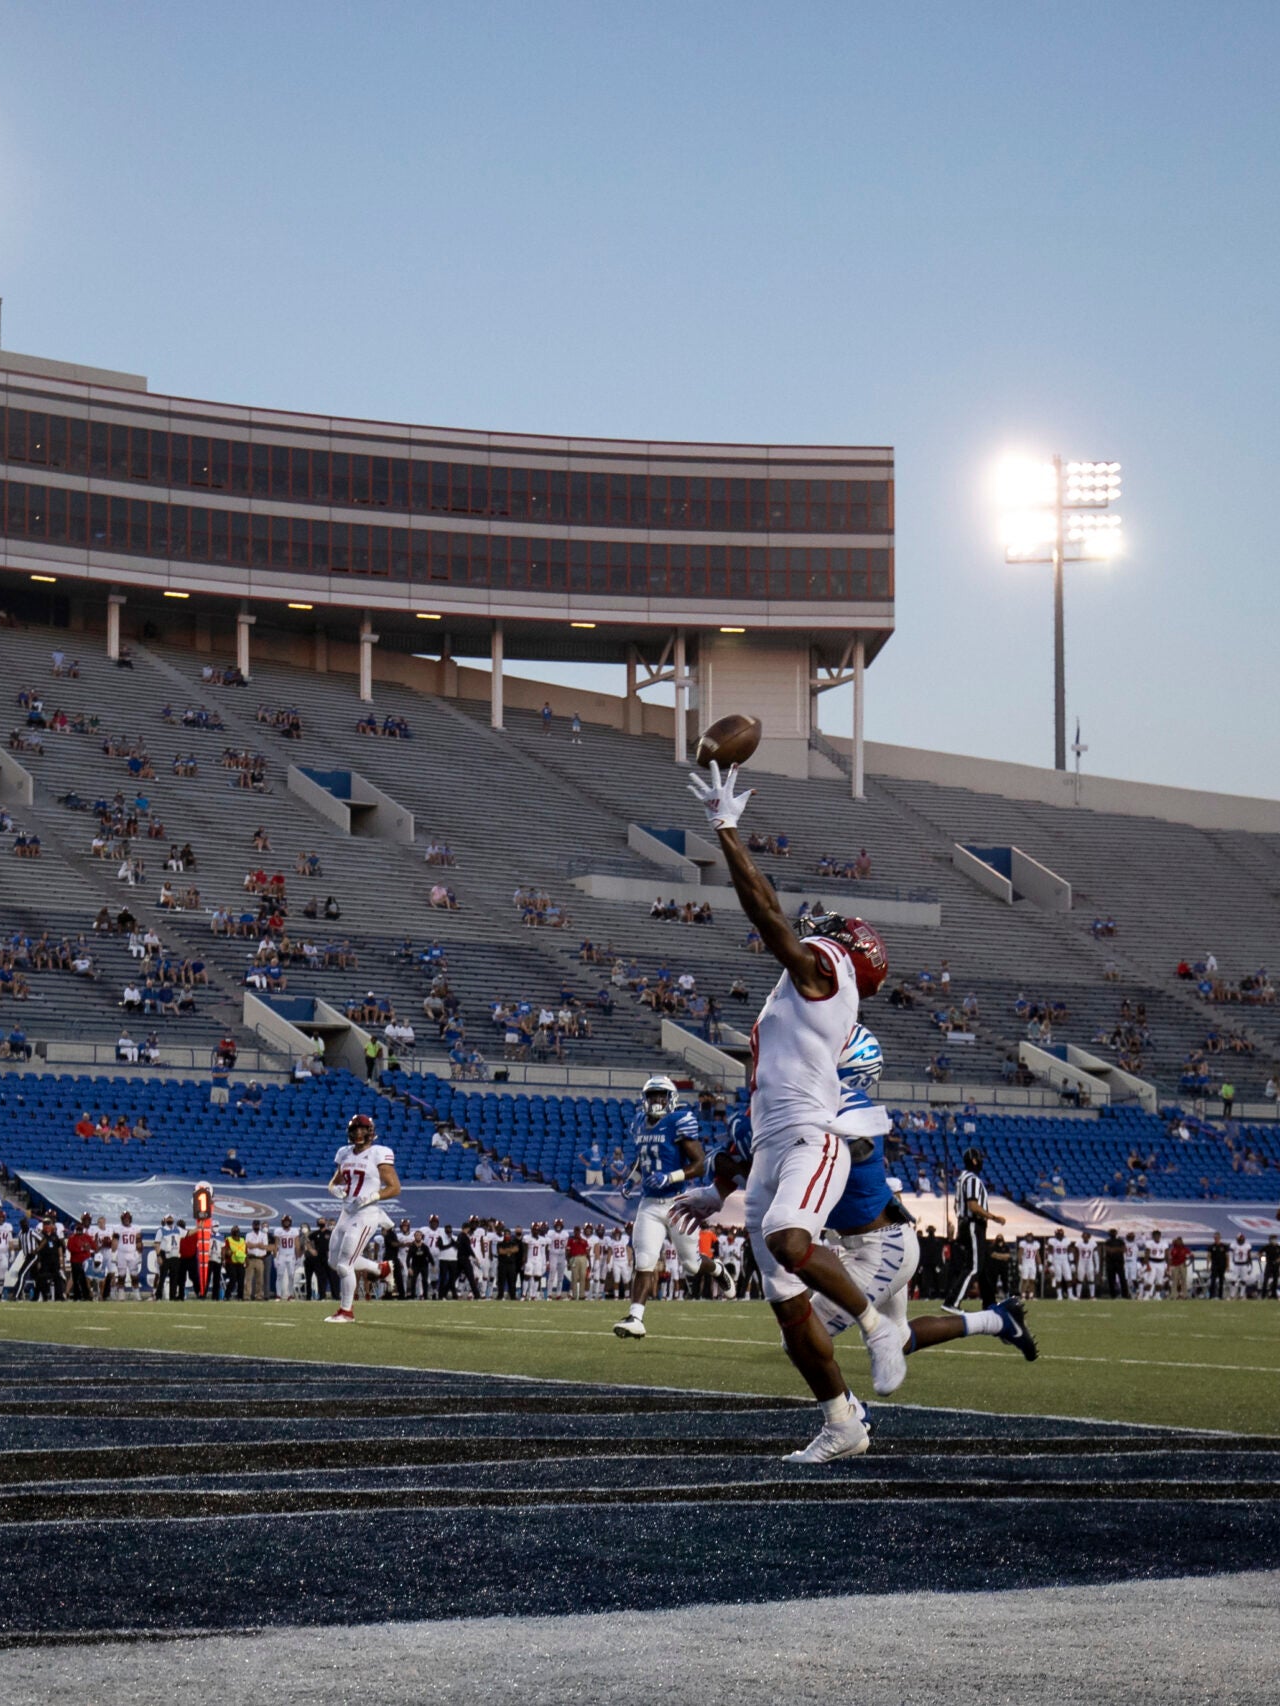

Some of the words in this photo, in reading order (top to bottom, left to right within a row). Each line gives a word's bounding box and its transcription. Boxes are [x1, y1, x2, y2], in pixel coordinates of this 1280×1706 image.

[197, 1192, 207, 1212] 1
[122, 1234, 135, 1245] 60
[281, 1237, 294, 1249] 80
[613, 1247, 625, 1258] 22
